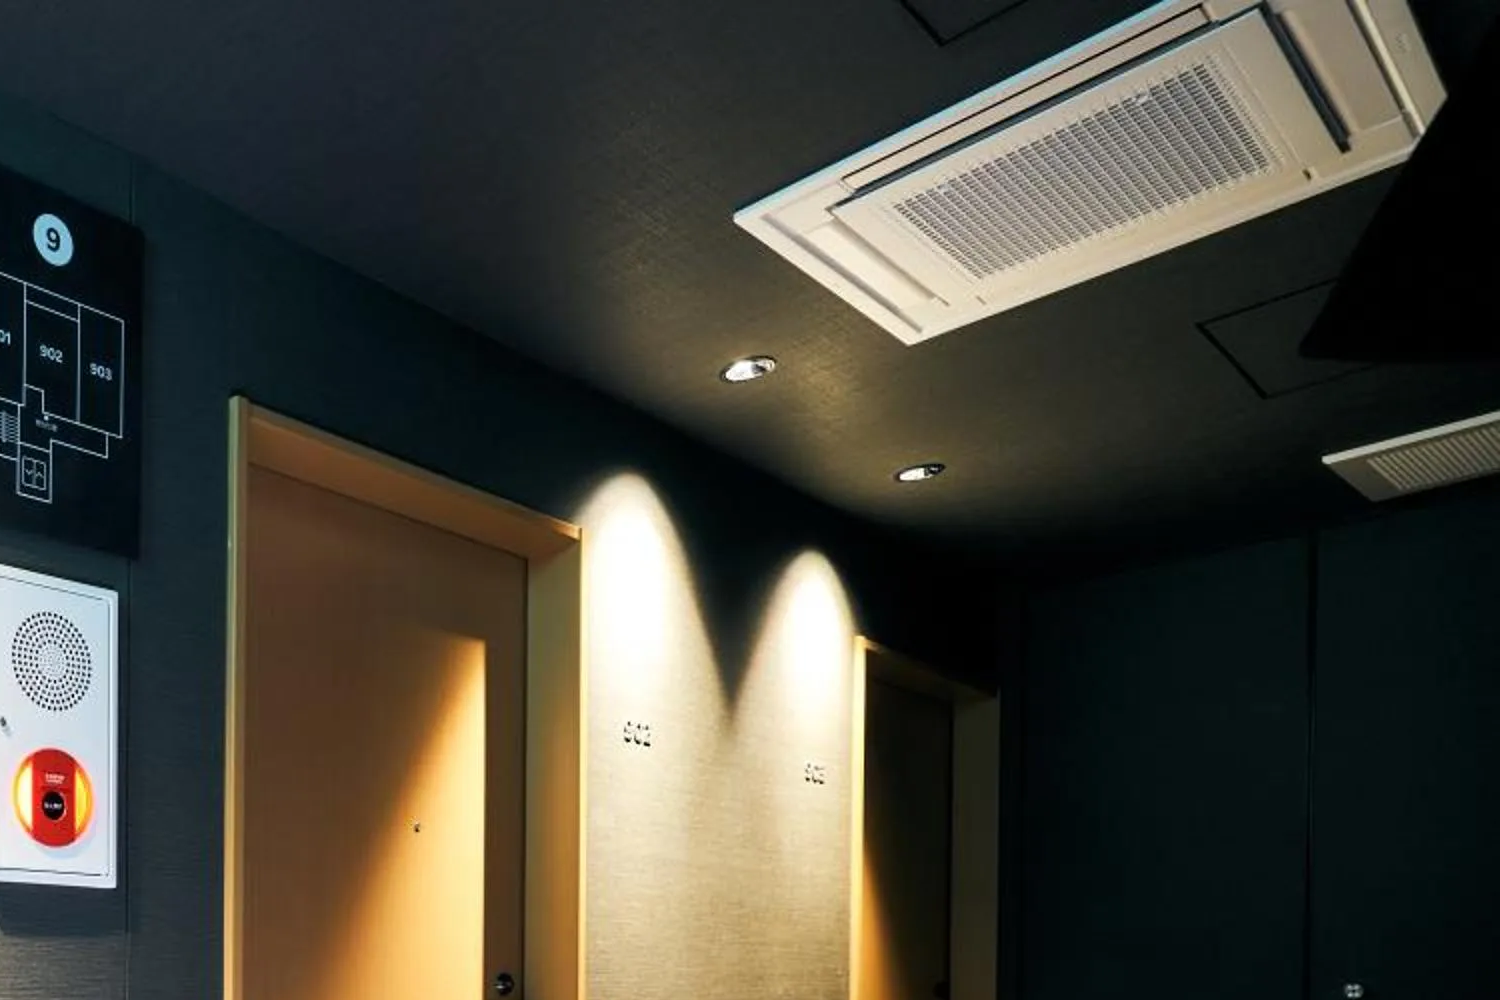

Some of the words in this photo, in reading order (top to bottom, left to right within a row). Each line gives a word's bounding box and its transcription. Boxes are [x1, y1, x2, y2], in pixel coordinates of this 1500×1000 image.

[46, 227, 61, 252] 9
[40, 345, 63, 363] 902
[89, 362, 112, 381] 903
